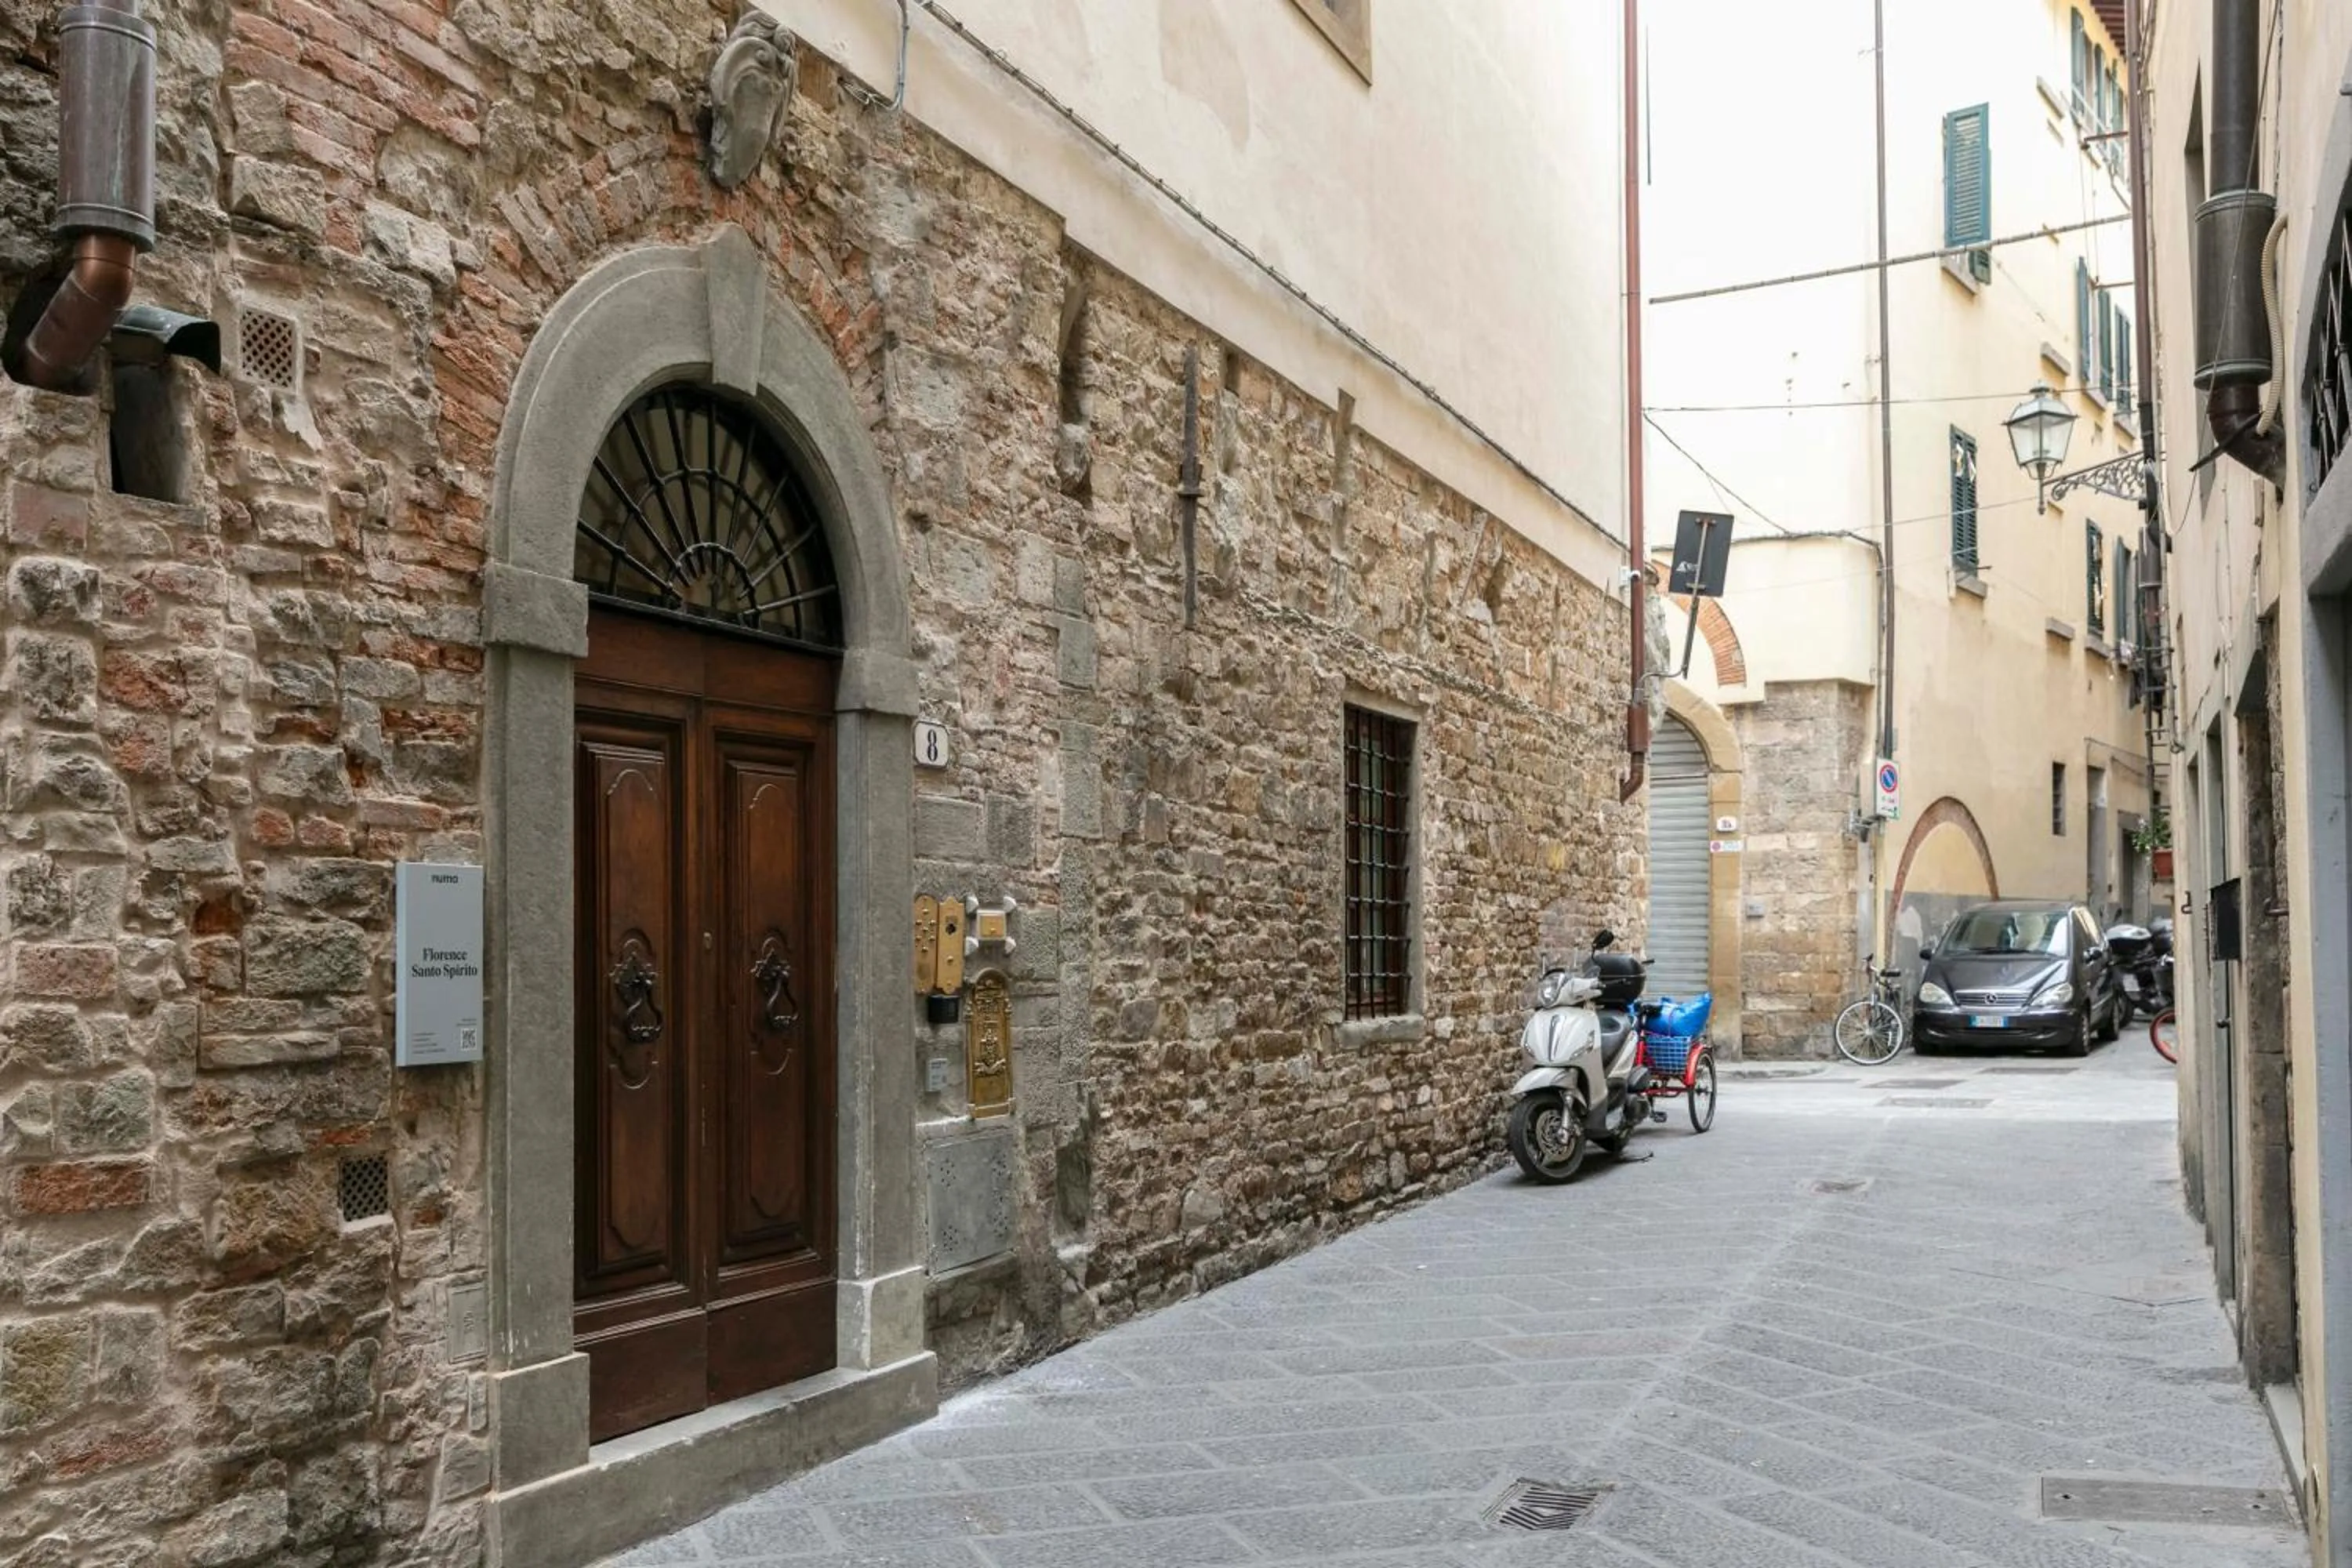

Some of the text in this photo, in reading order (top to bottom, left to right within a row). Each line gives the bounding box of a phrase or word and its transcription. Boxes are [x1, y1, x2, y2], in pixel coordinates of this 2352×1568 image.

[927, 729, 938, 762] 8
[423, 948, 468, 961] Florence
[412, 964, 477, 980] Santo Spirito
